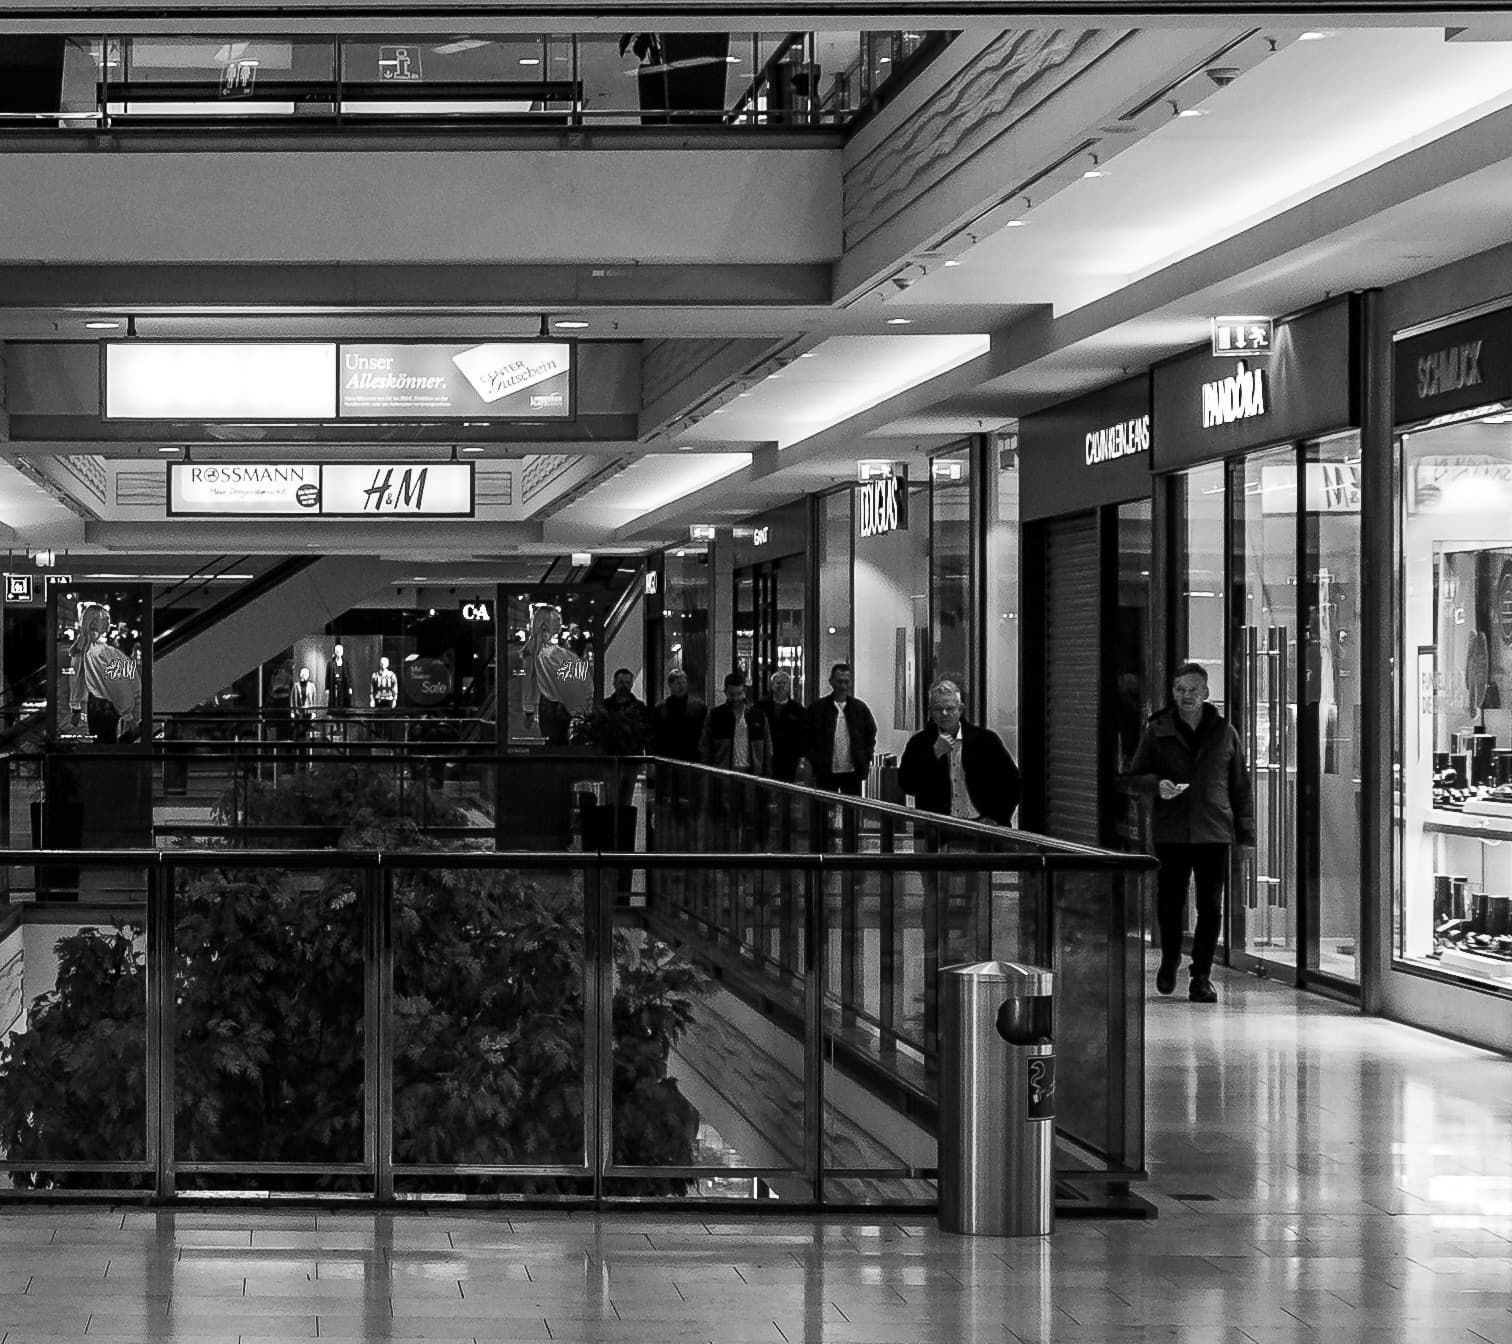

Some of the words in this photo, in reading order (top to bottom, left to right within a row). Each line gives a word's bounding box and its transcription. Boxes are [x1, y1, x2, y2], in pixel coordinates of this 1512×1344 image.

[344, 353, 394, 370] Unser
[345, 372, 448, 390] Alleskönner.
[1417, 340, 1483, 398] SCHMUCK
[1202, 364, 1265, 429] PANDORA
[191, 467, 304, 483] ROSSMANN
[363, 467, 428, 511] H&M
[860, 476, 897, 537] DOUGLAS
